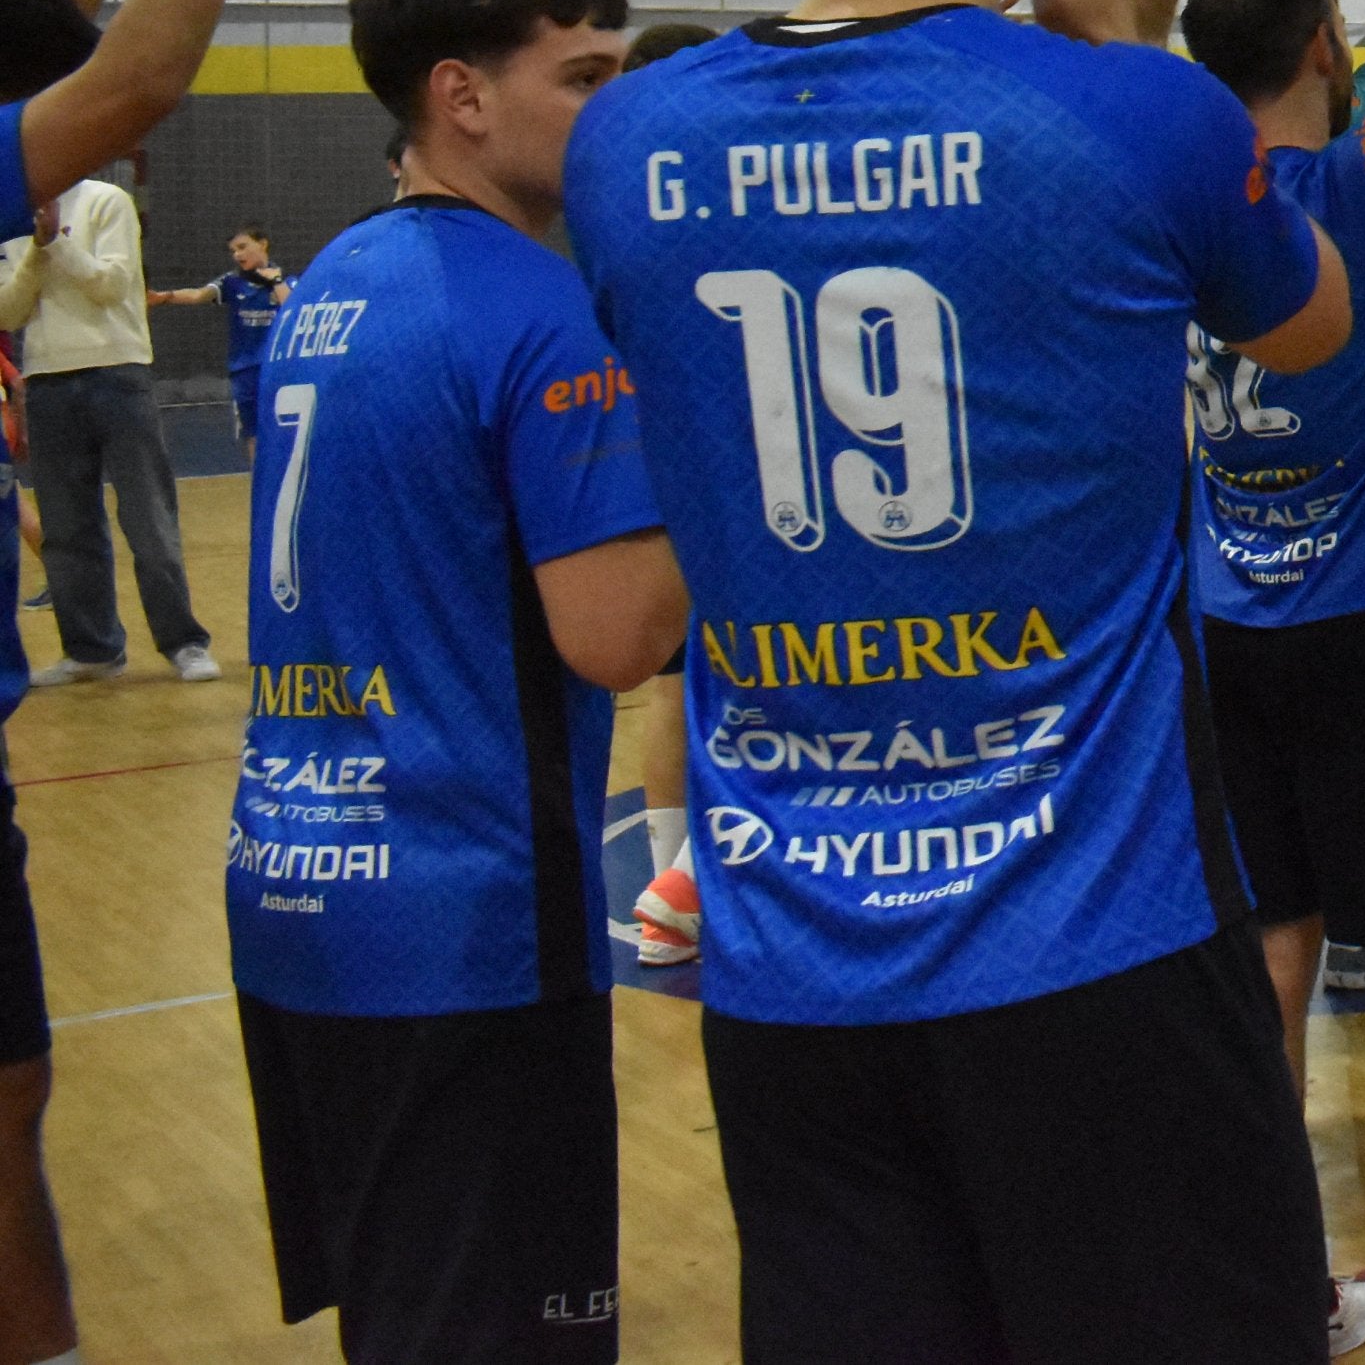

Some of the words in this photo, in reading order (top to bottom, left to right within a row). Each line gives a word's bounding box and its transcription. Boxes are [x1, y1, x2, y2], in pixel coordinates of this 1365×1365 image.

[647, 150, 712, 222] G.
[727, 131, 983, 218] PULGAR
[286, 291, 368, 359] PÉREZ
[695, 265, 975, 553] 19
[269, 382, 318, 614] 7
[706, 703, 1067, 773] GONZÁLEZ
[857, 757, 1063, 808] AUTOBUSES
[239, 838, 390, 881] HYUNDAI
[260, 891, 325, 914] Asturdai
[860, 873, 976, 909] Asturdai
[542, 1293, 574, 1320] EL
